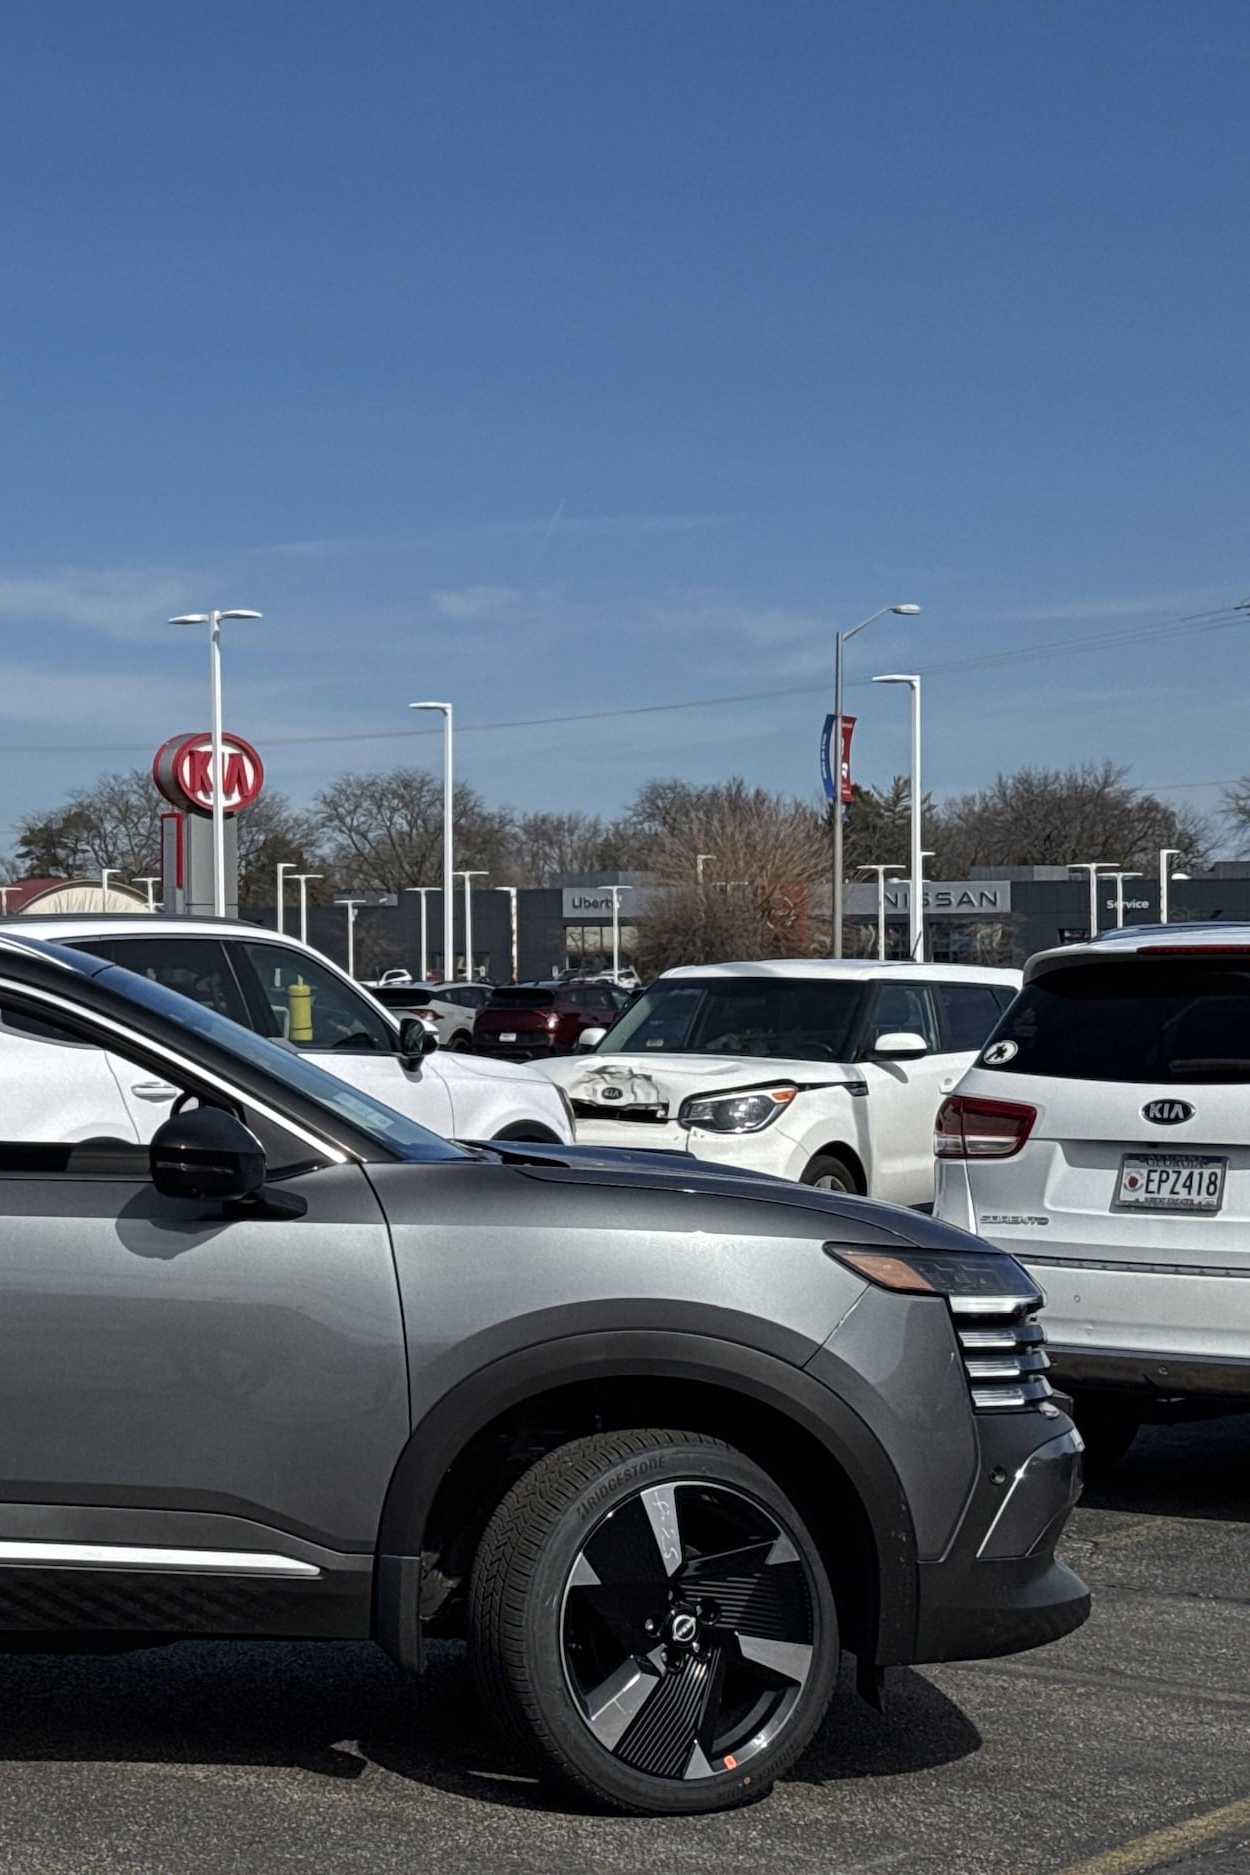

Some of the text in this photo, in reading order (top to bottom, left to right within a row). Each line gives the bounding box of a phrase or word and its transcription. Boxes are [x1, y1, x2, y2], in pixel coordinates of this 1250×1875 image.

[188, 750, 250, 800] KA
[572, 896, 620, 911] Libert
[1149, 1103, 1184, 1119] KIA
[1145, 1169, 1219, 1197] EPZ418
[576, 1456, 665, 1519] BRIDGESTONE
